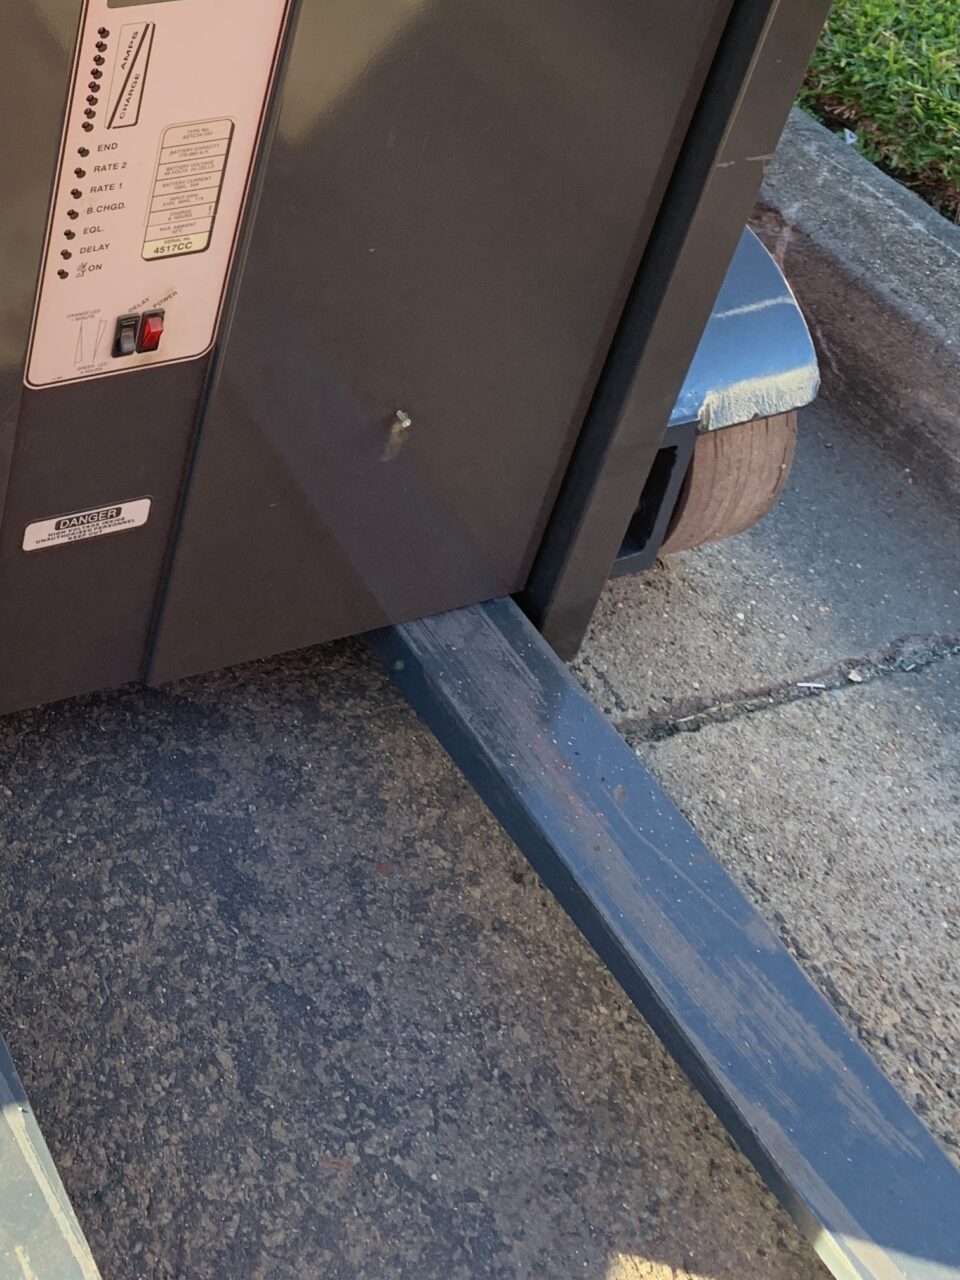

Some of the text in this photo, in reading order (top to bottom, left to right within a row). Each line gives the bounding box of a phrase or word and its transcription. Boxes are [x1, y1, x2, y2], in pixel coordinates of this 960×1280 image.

[121, 31, 138, 70] AMPS
[119, 73, 140, 119] CHARGE
[97, 143, 118, 152] END
[94, 163, 119, 173] RATE
[90, 184, 115, 193] RATE
[80, 243, 110, 254] DELAY
[153, 242, 193, 254] 4517CC
[88, 264, 102, 272] ON
[128, 297, 150, 313] DELAY
[152, 291, 178, 308] POWER
[60, 509, 117, 529] DANGER
